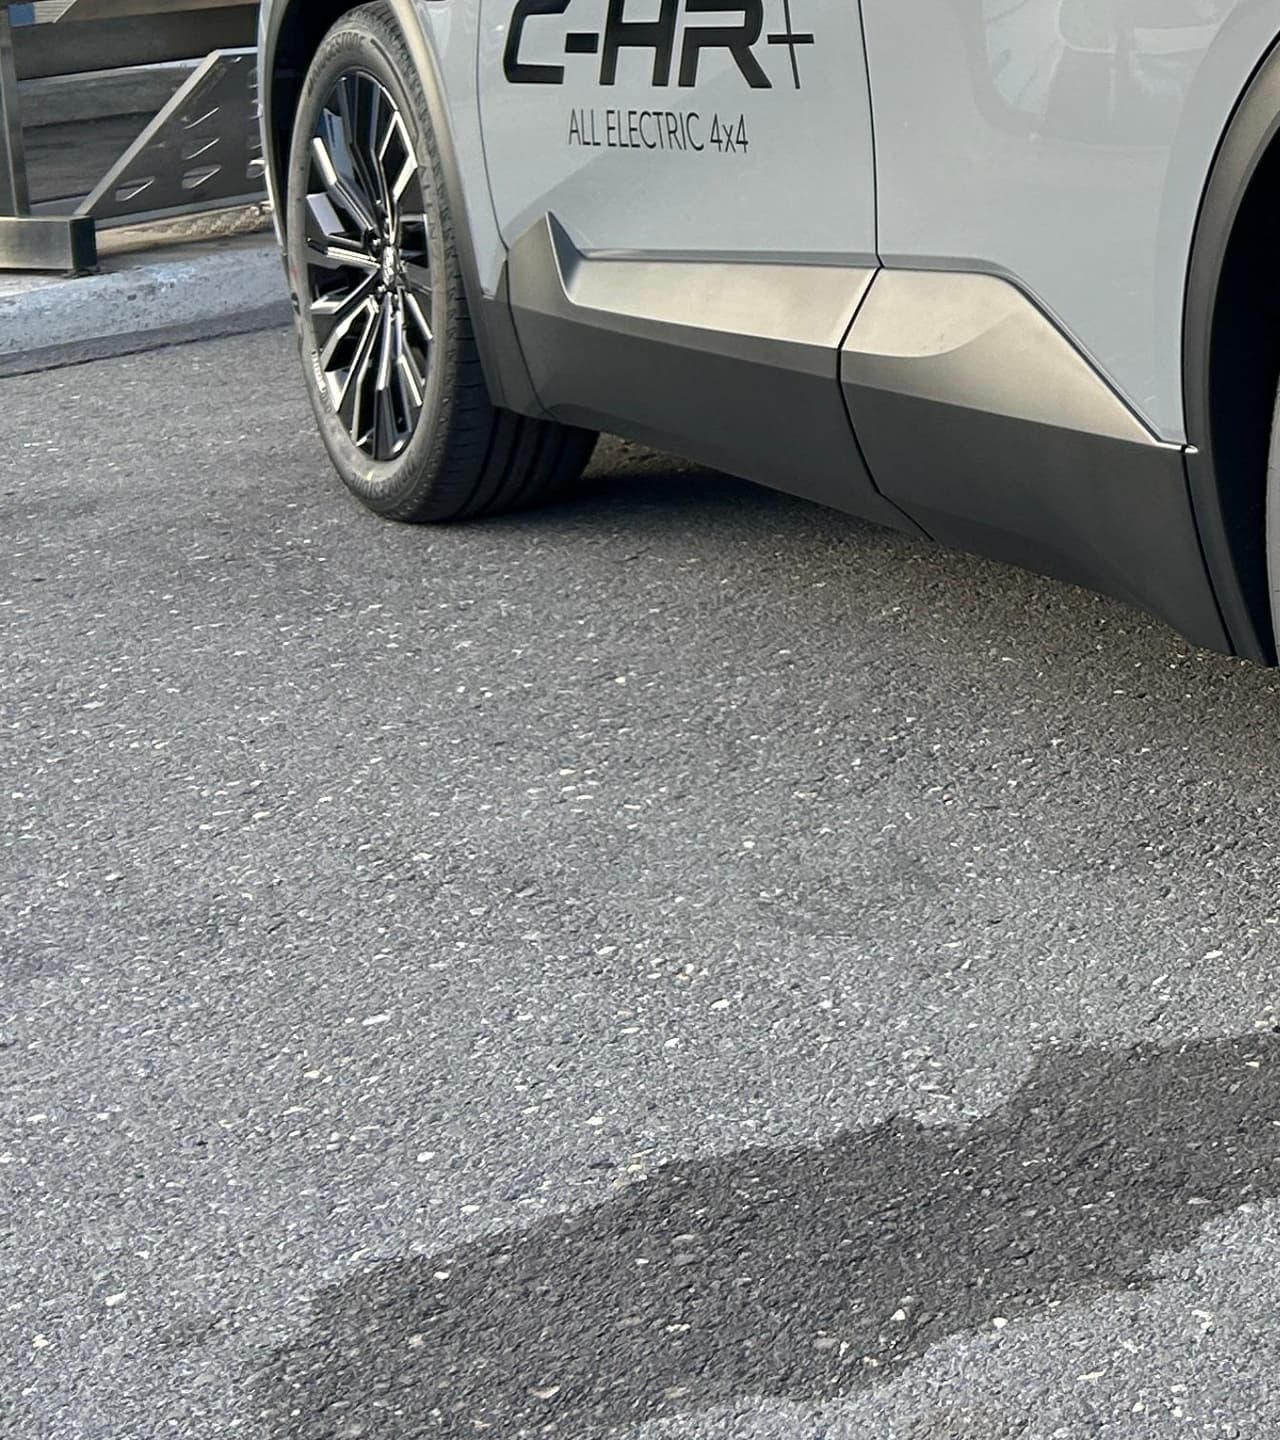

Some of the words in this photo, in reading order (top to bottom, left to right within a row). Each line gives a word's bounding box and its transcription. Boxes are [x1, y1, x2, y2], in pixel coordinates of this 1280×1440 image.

[568, 108, 601, 146] ALL
[606, 109, 705, 151] ELECTRIC
[709, 113, 749, 154] 4x4
